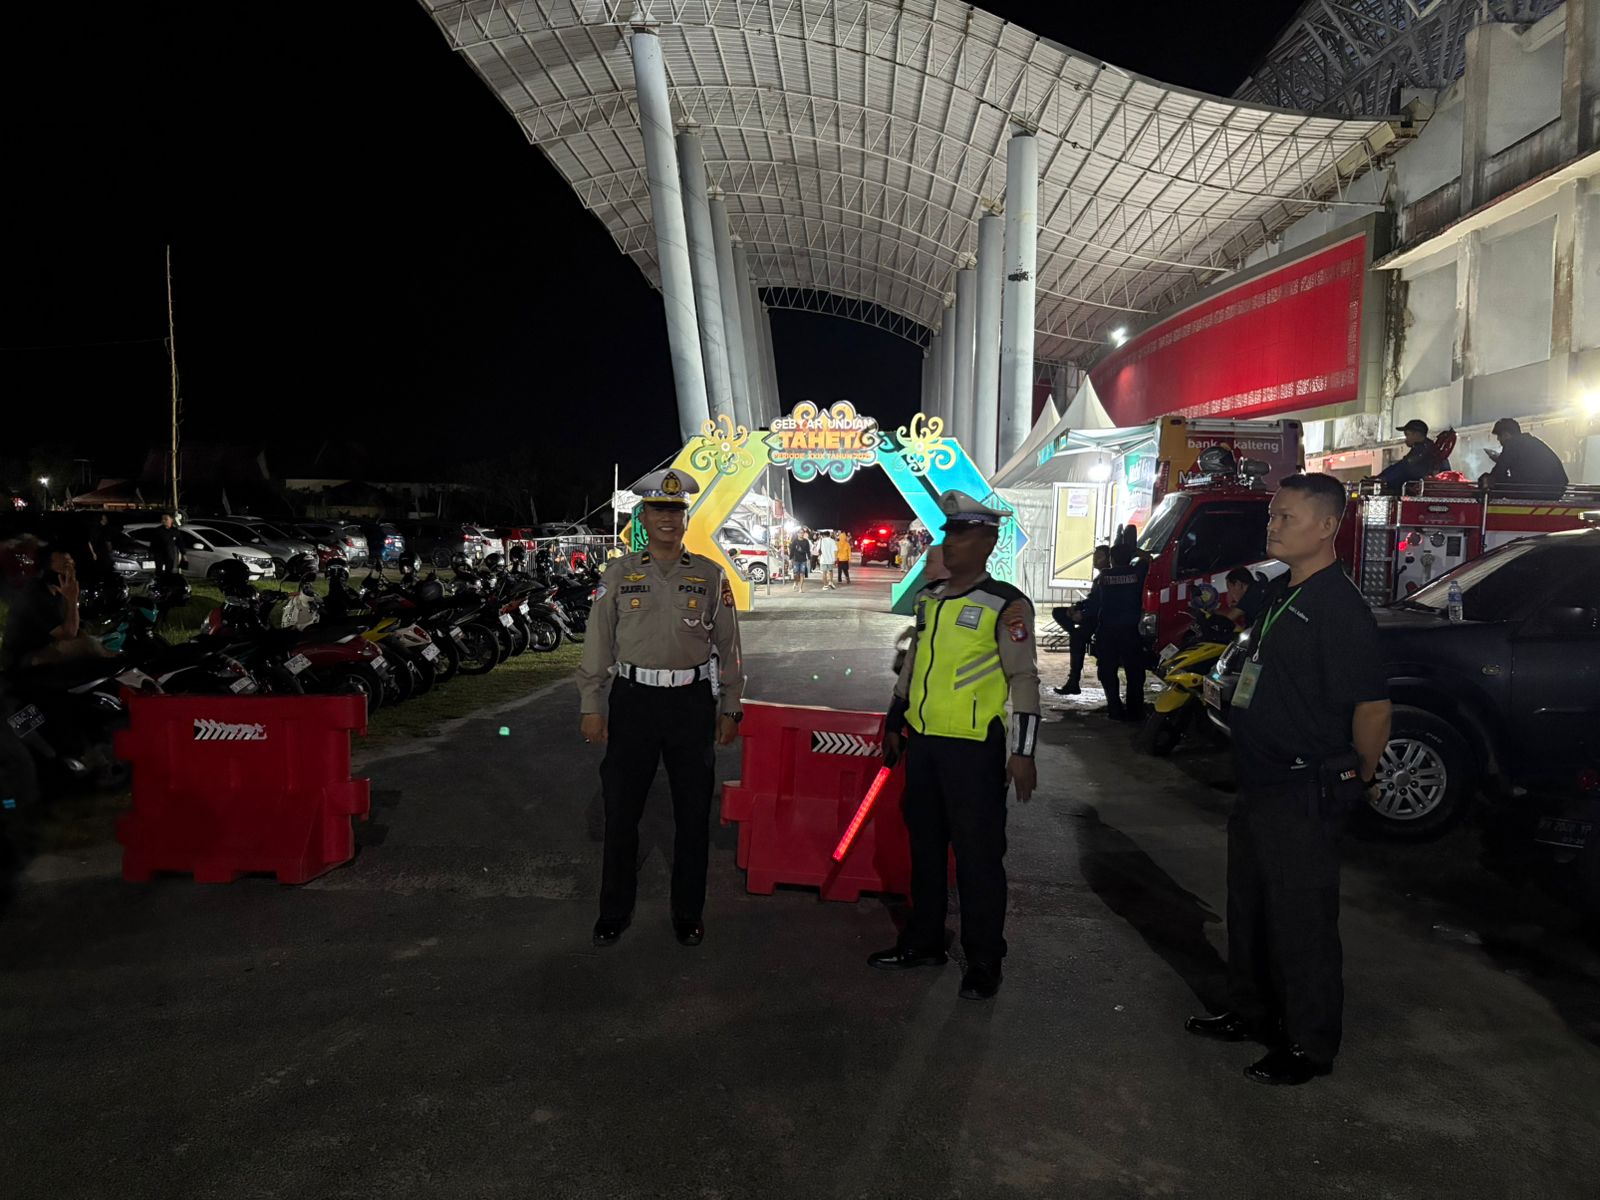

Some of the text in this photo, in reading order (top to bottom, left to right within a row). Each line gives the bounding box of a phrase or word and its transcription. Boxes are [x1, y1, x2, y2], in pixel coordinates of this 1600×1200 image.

[775, 419, 873, 429] GEBYAR UNDIAN
[1187, 439, 1279, 453] bank kalteng
[678, 584, 707, 596] POLRI
